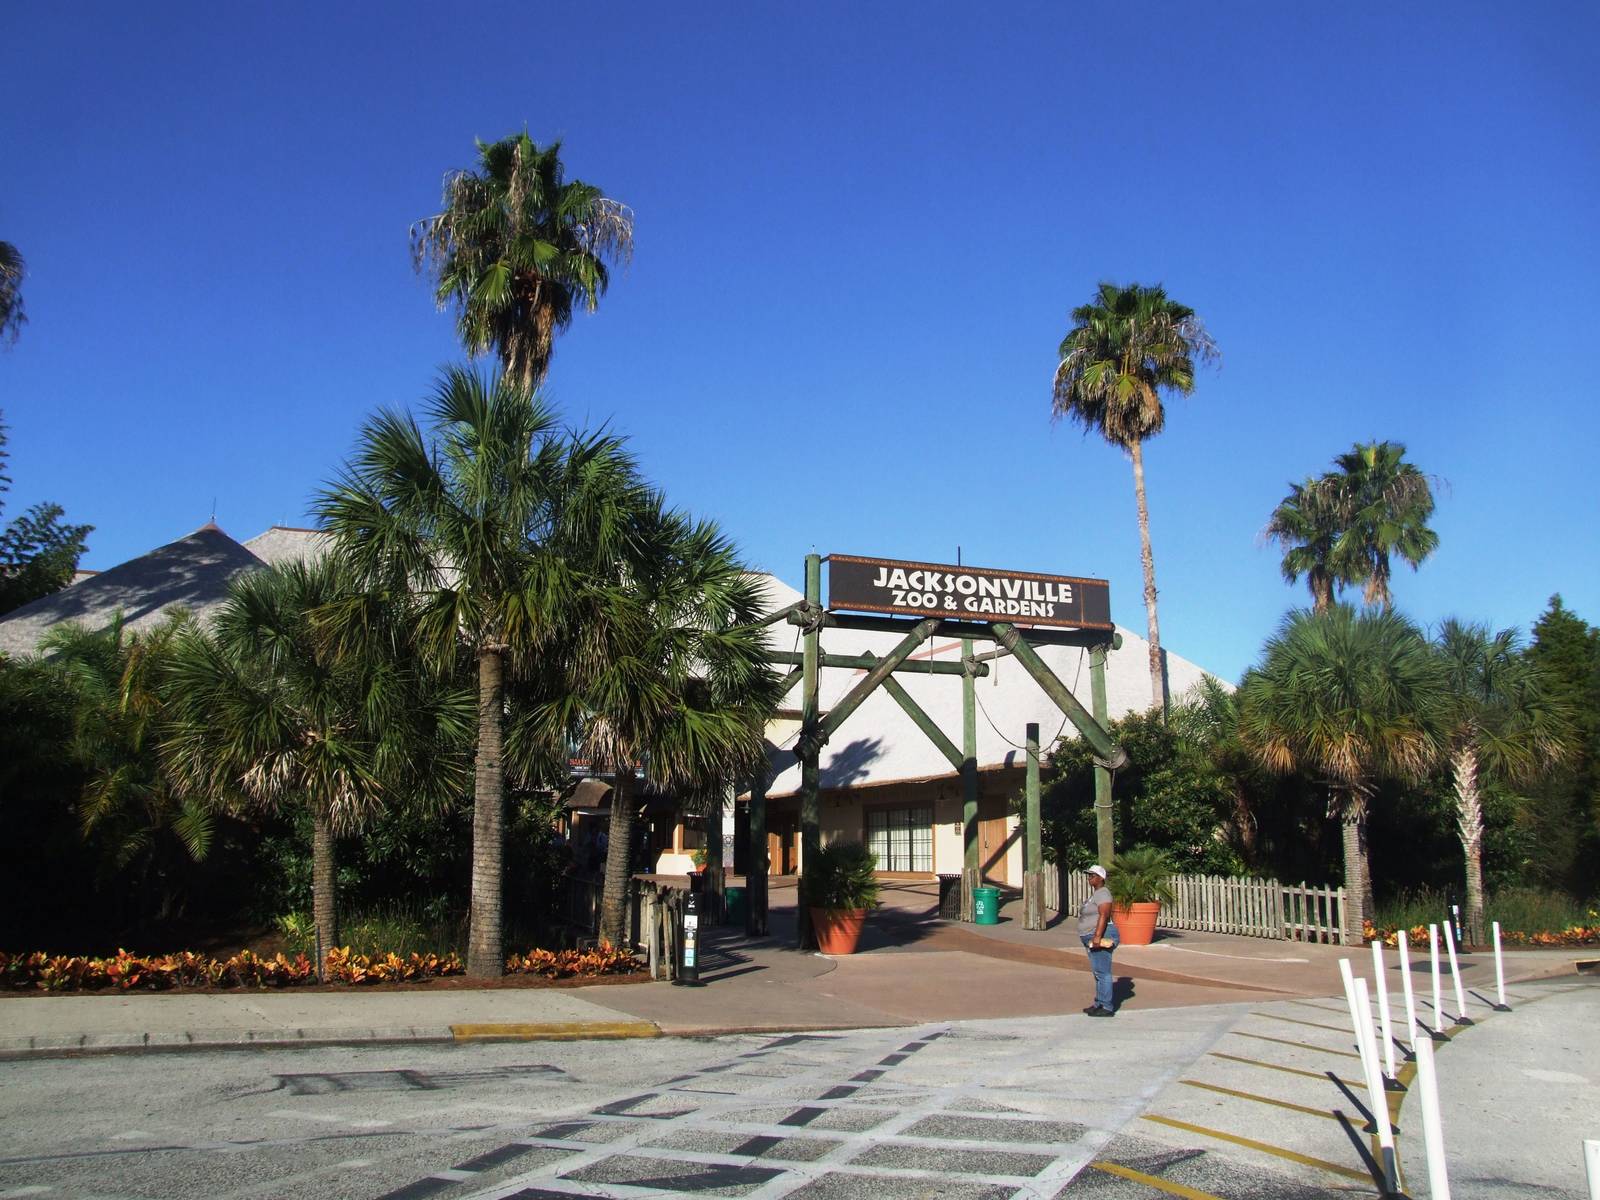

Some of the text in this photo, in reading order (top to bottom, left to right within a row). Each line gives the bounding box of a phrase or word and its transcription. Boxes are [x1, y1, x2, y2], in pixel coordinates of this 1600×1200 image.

[873, 567, 1073, 604] JACKSONVILLE
[891, 590, 1055, 618] ZOO & GARDENS
